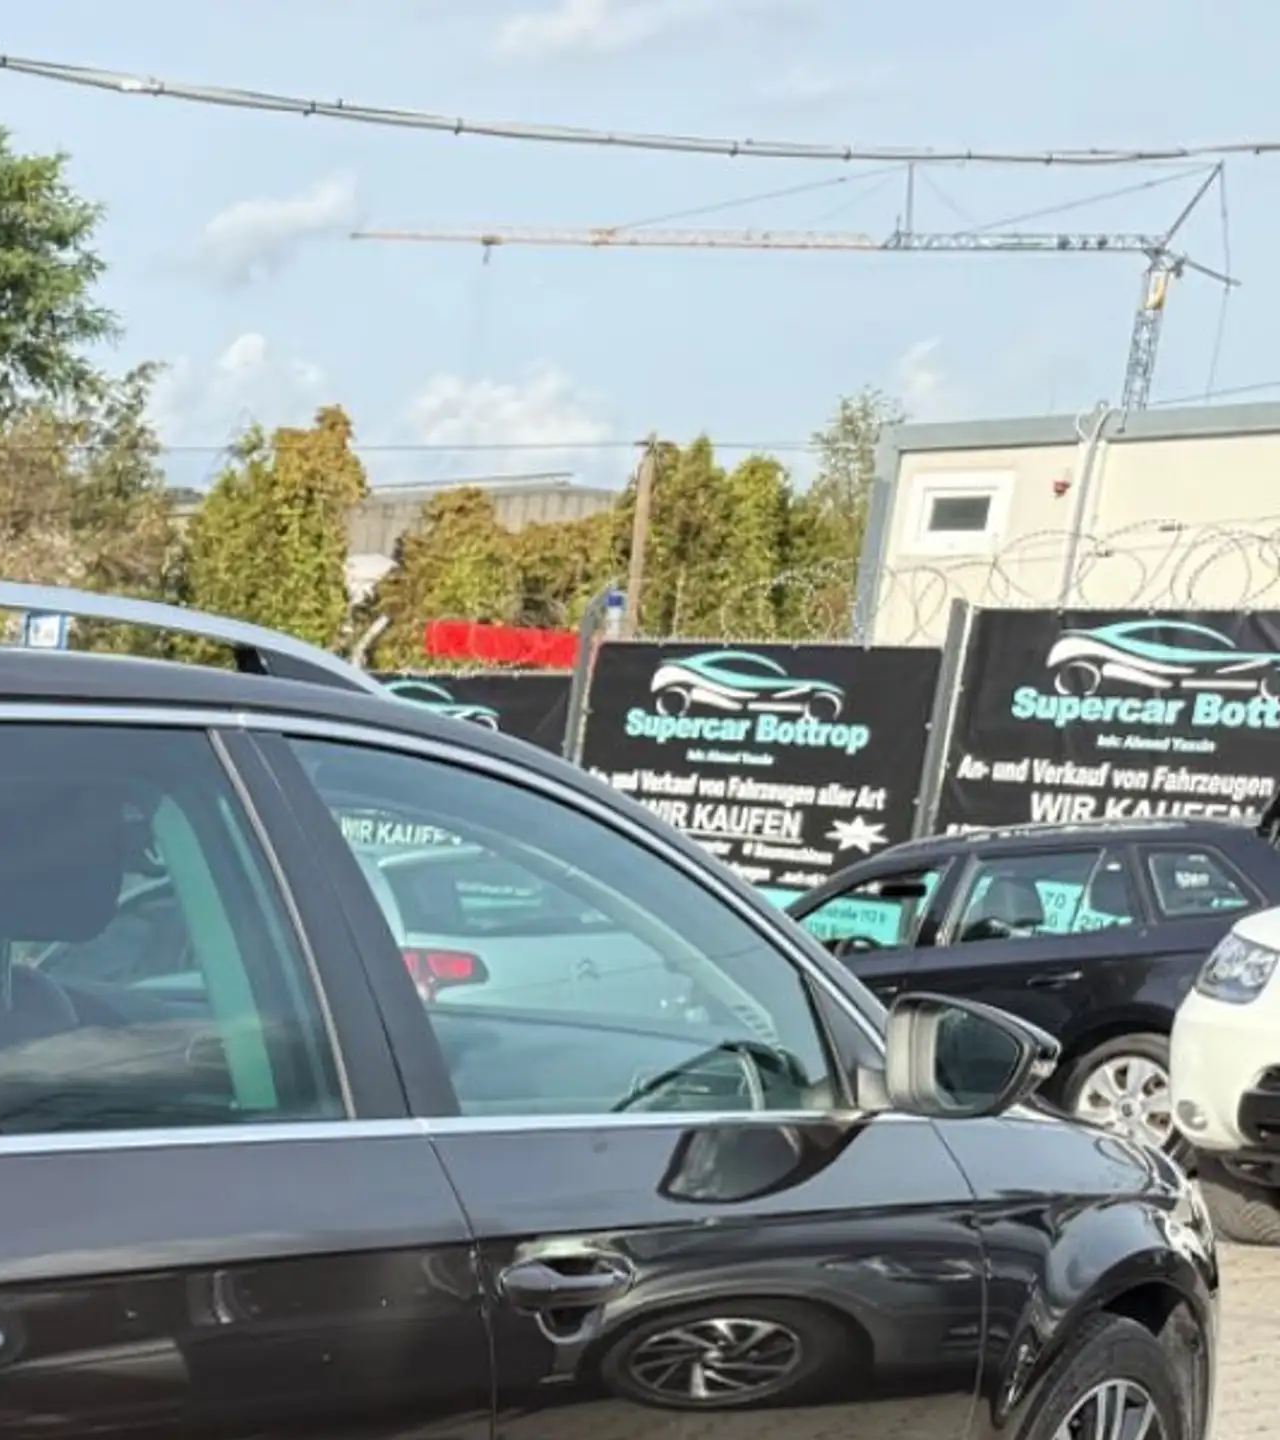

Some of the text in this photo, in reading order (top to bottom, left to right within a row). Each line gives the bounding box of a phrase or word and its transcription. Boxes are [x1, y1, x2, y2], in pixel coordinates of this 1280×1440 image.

[1011, 686, 1184, 727] Supercar
[625, 706, 870, 755] Supercar Bottrop
[855, 785, 887, 811] Art
[989, 758, 1029, 783] und
[1032, 757, 1111, 788] Verkauf
[1112, 767, 1149, 790] von
[1151, 765, 1274, 802] Fahrzeugen
[692, 802, 804, 838] KAUFEN
[1030, 790, 1096, 824] WIR
